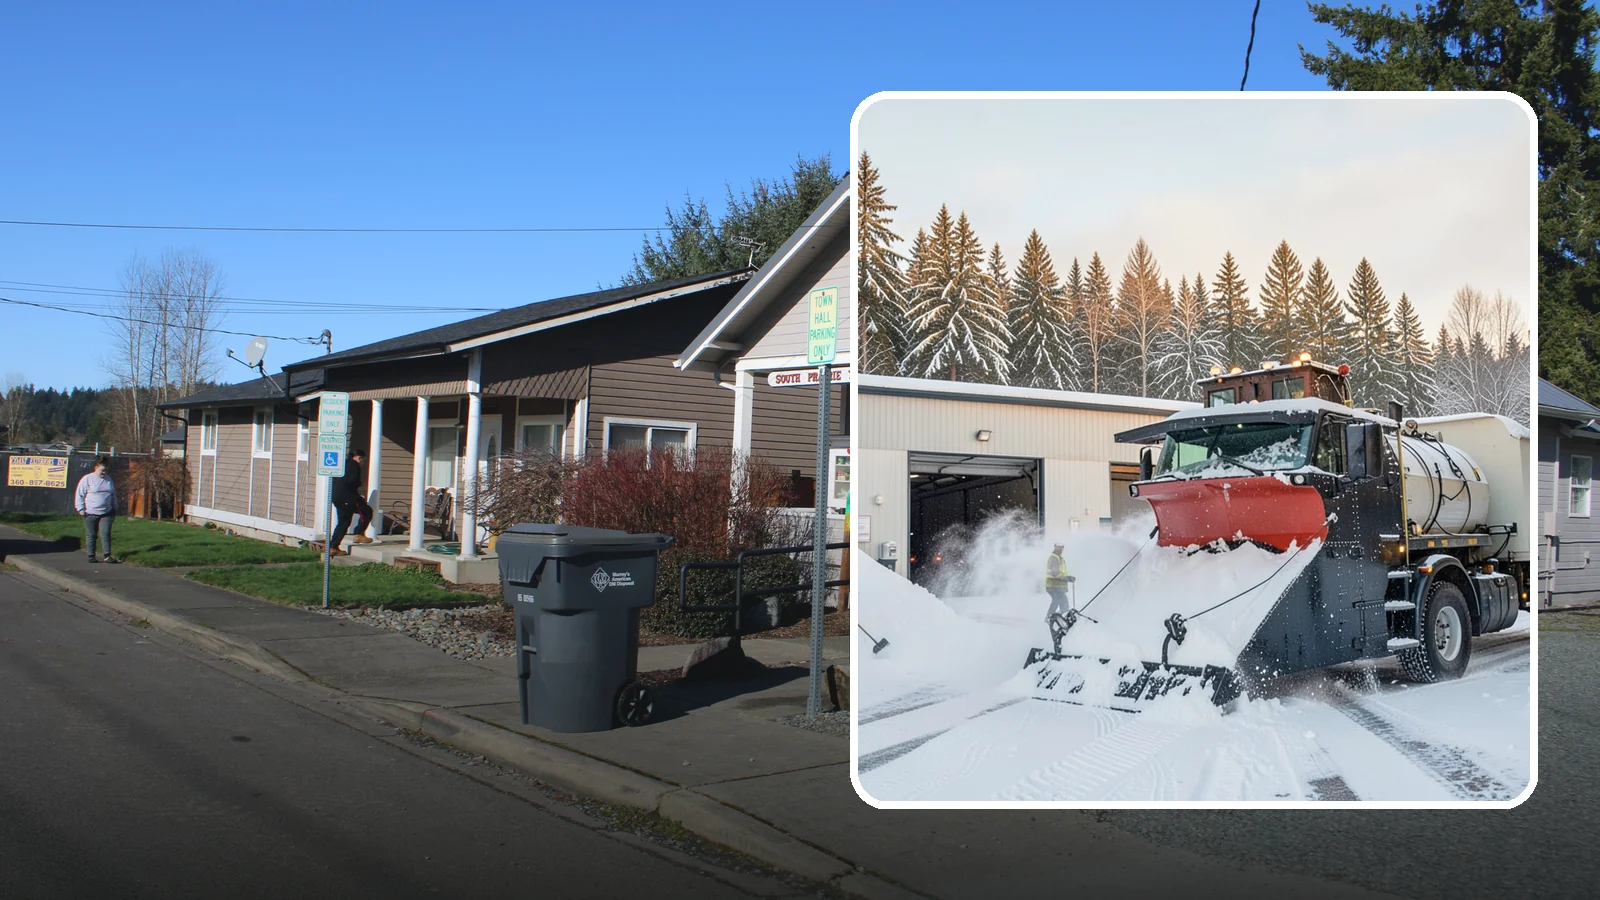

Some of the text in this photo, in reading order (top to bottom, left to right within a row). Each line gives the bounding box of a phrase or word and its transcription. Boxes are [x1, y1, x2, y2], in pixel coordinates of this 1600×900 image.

[815, 294, 833, 308] TOWN
[815, 311, 831, 324] HALL
[810, 326, 835, 341] PARKING
[814, 344, 831, 357] ONLY
[775, 374, 801, 384] SOUTH
[808, 370, 842, 382] PRIE
